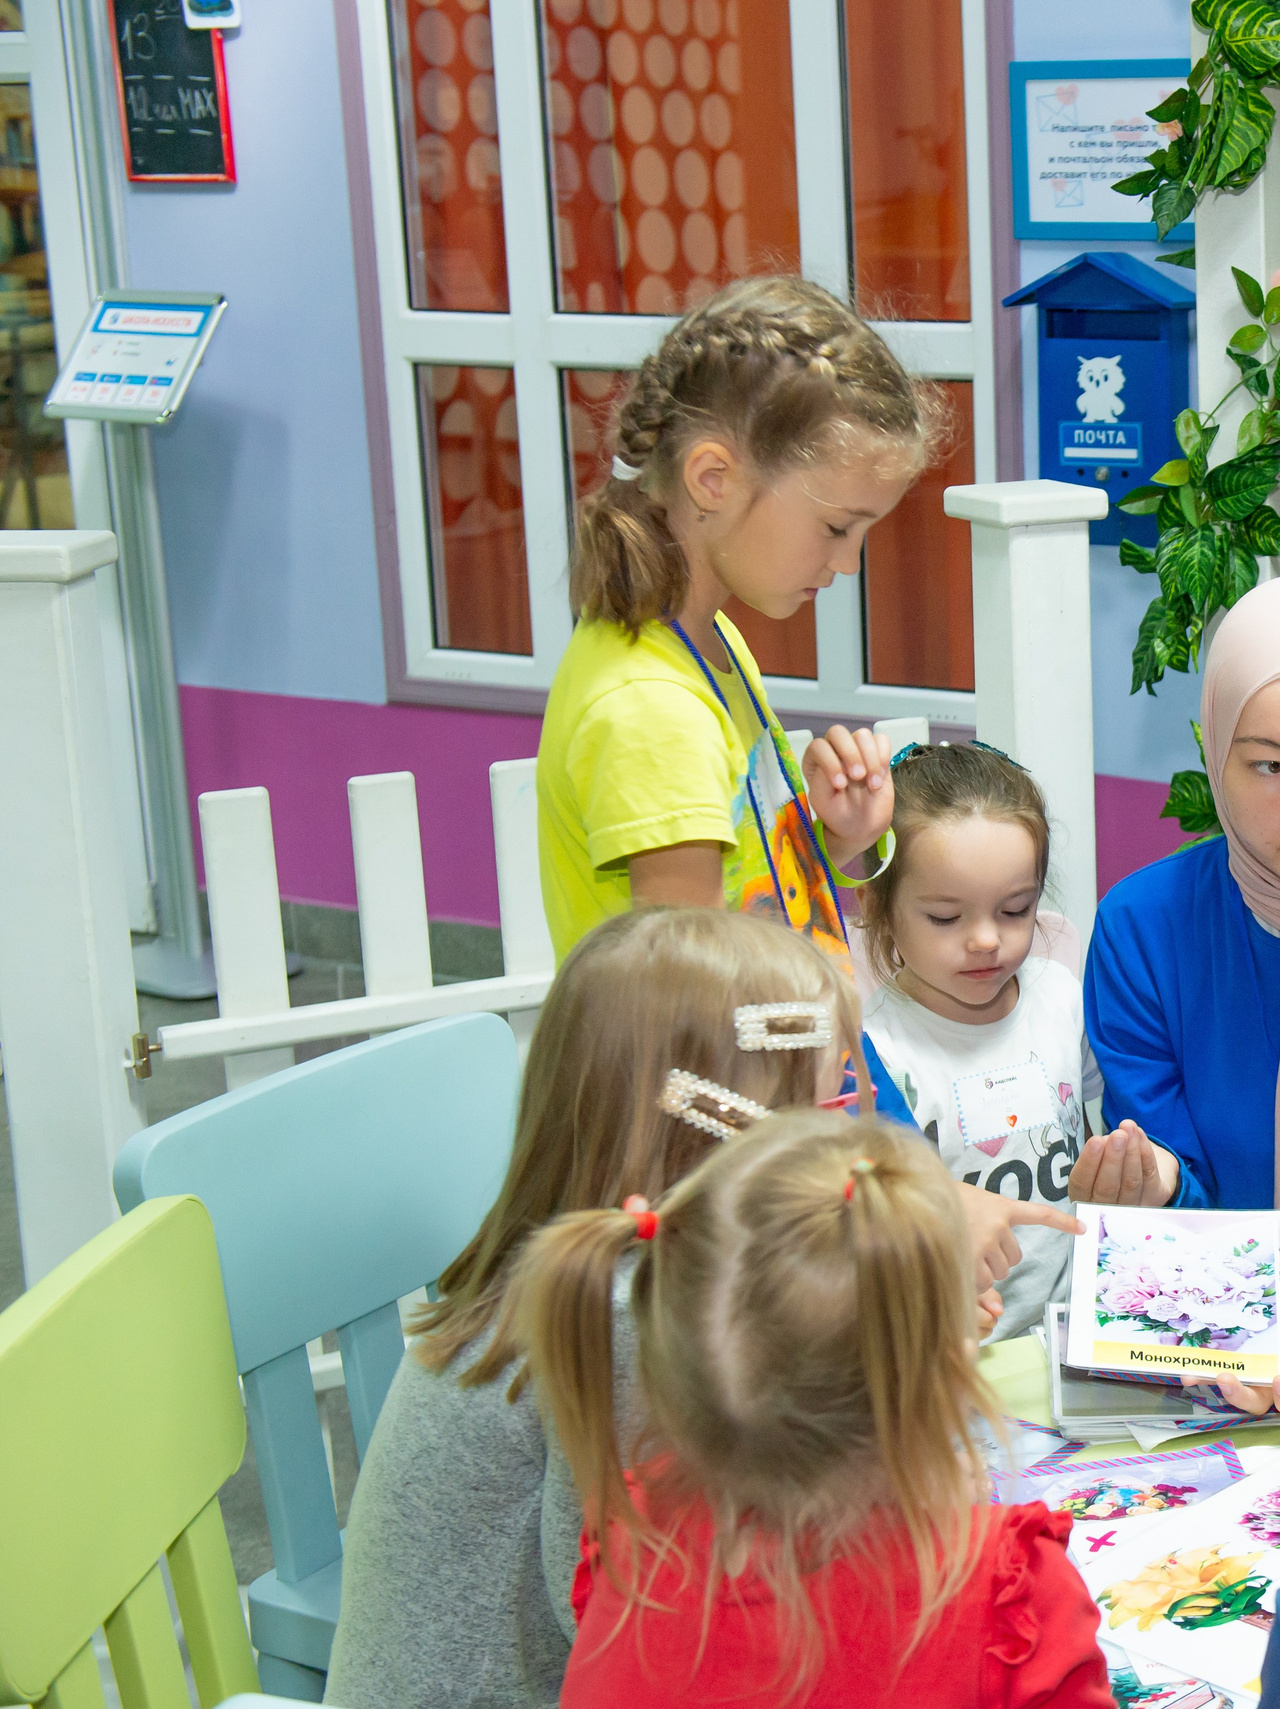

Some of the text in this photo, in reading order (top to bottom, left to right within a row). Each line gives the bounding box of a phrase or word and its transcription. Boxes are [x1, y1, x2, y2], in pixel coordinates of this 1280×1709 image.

[1051, 124, 1105, 132] Напишите
[1110, 124, 1149, 132] письмо
[1078, 140, 1097, 148] кем
[1099, 140, 1113, 148] вы
[1115, 154, 1147, 163] обяза
[1040, 171, 1088, 180] доставит
[1090, 171, 1107, 179] его
[1110, 171, 1123, 179] по
[1074, 429, 1126, 444] ПОЧТА
[1129, 1350, 1245, 1371] Монохромный
